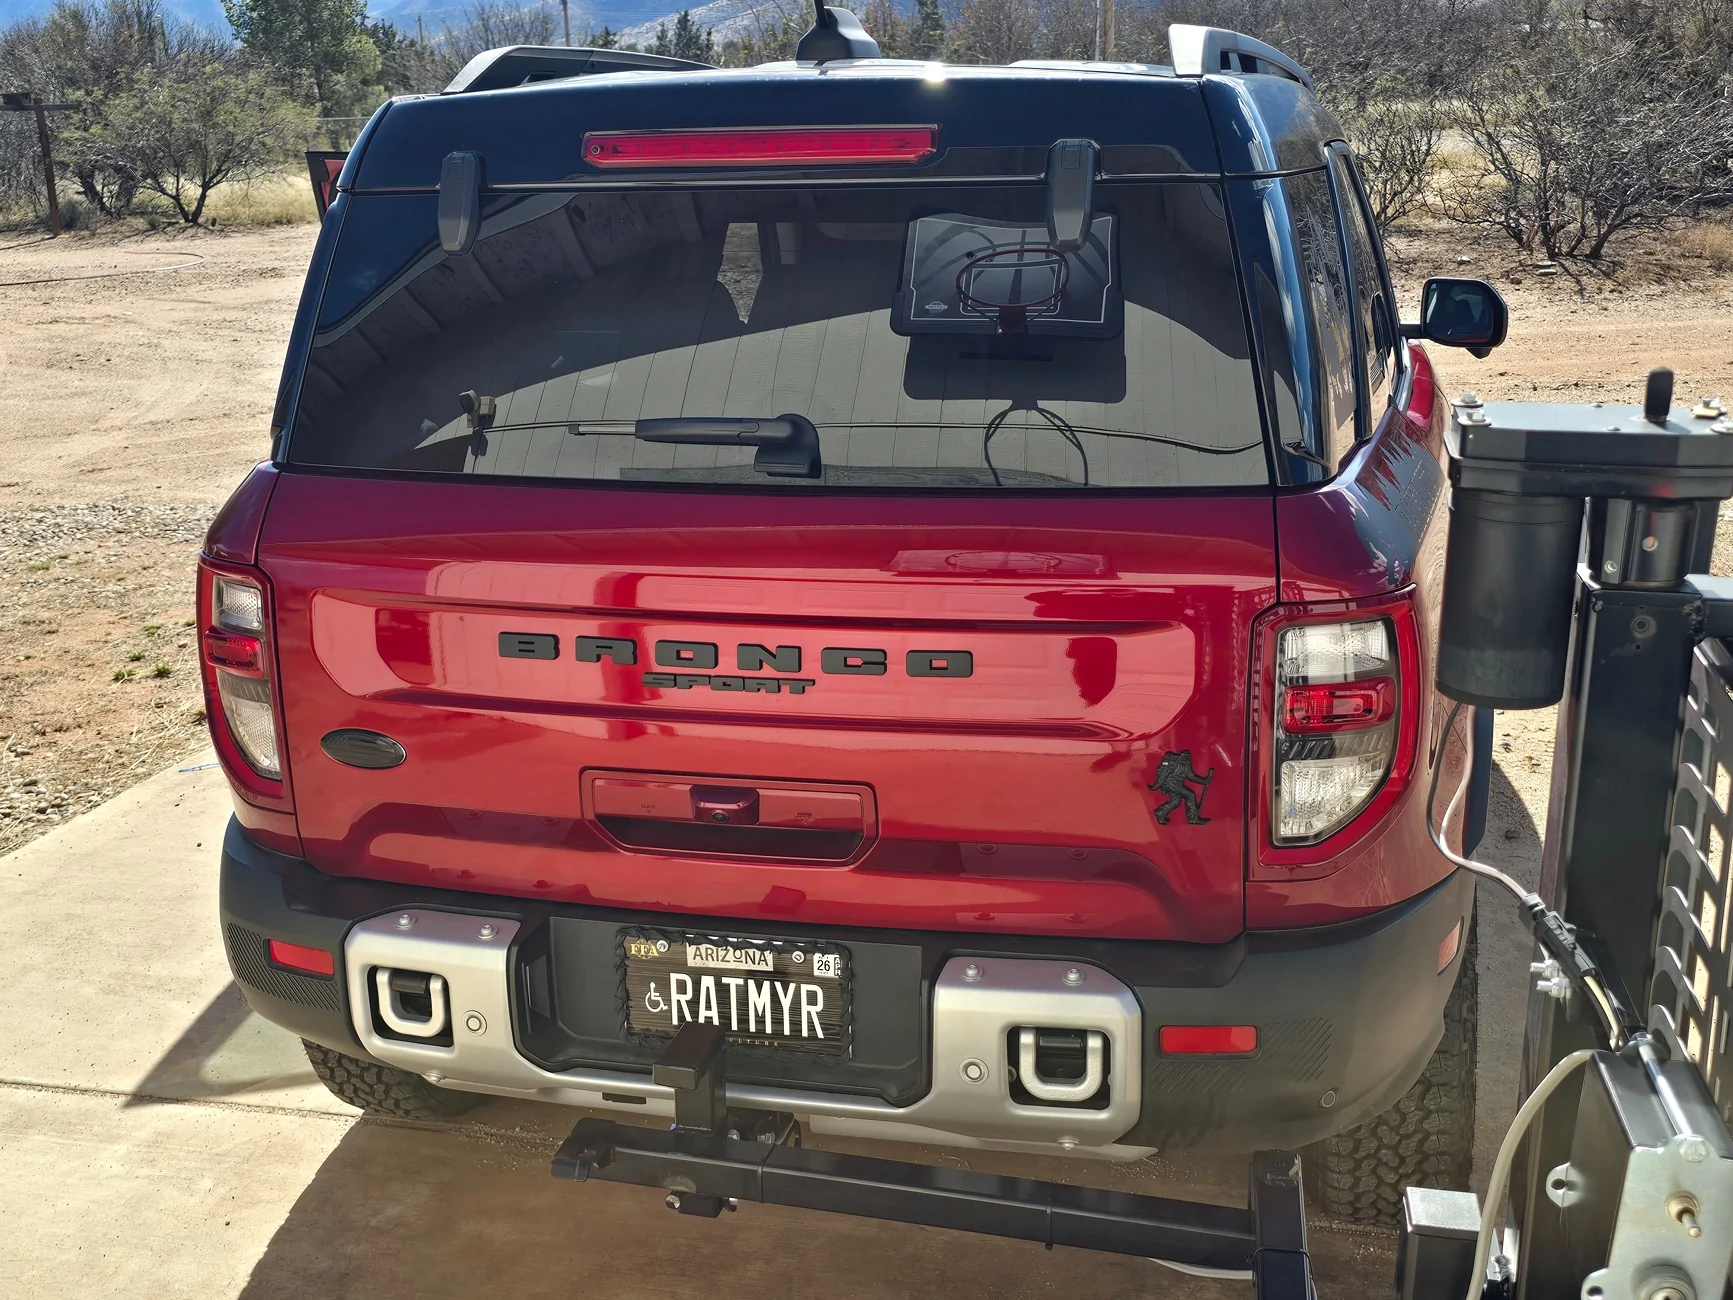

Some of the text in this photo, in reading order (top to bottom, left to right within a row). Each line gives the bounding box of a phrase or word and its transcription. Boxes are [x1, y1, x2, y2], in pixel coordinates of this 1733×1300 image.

[498, 631, 974, 678] BRONCO
[642, 671, 816, 695] SPORT
[630, 943, 659, 957] FFA
[693, 946, 769, 967] ARIZONA
[817, 959, 831, 972] 26
[669, 972, 825, 1039] RATMYR
